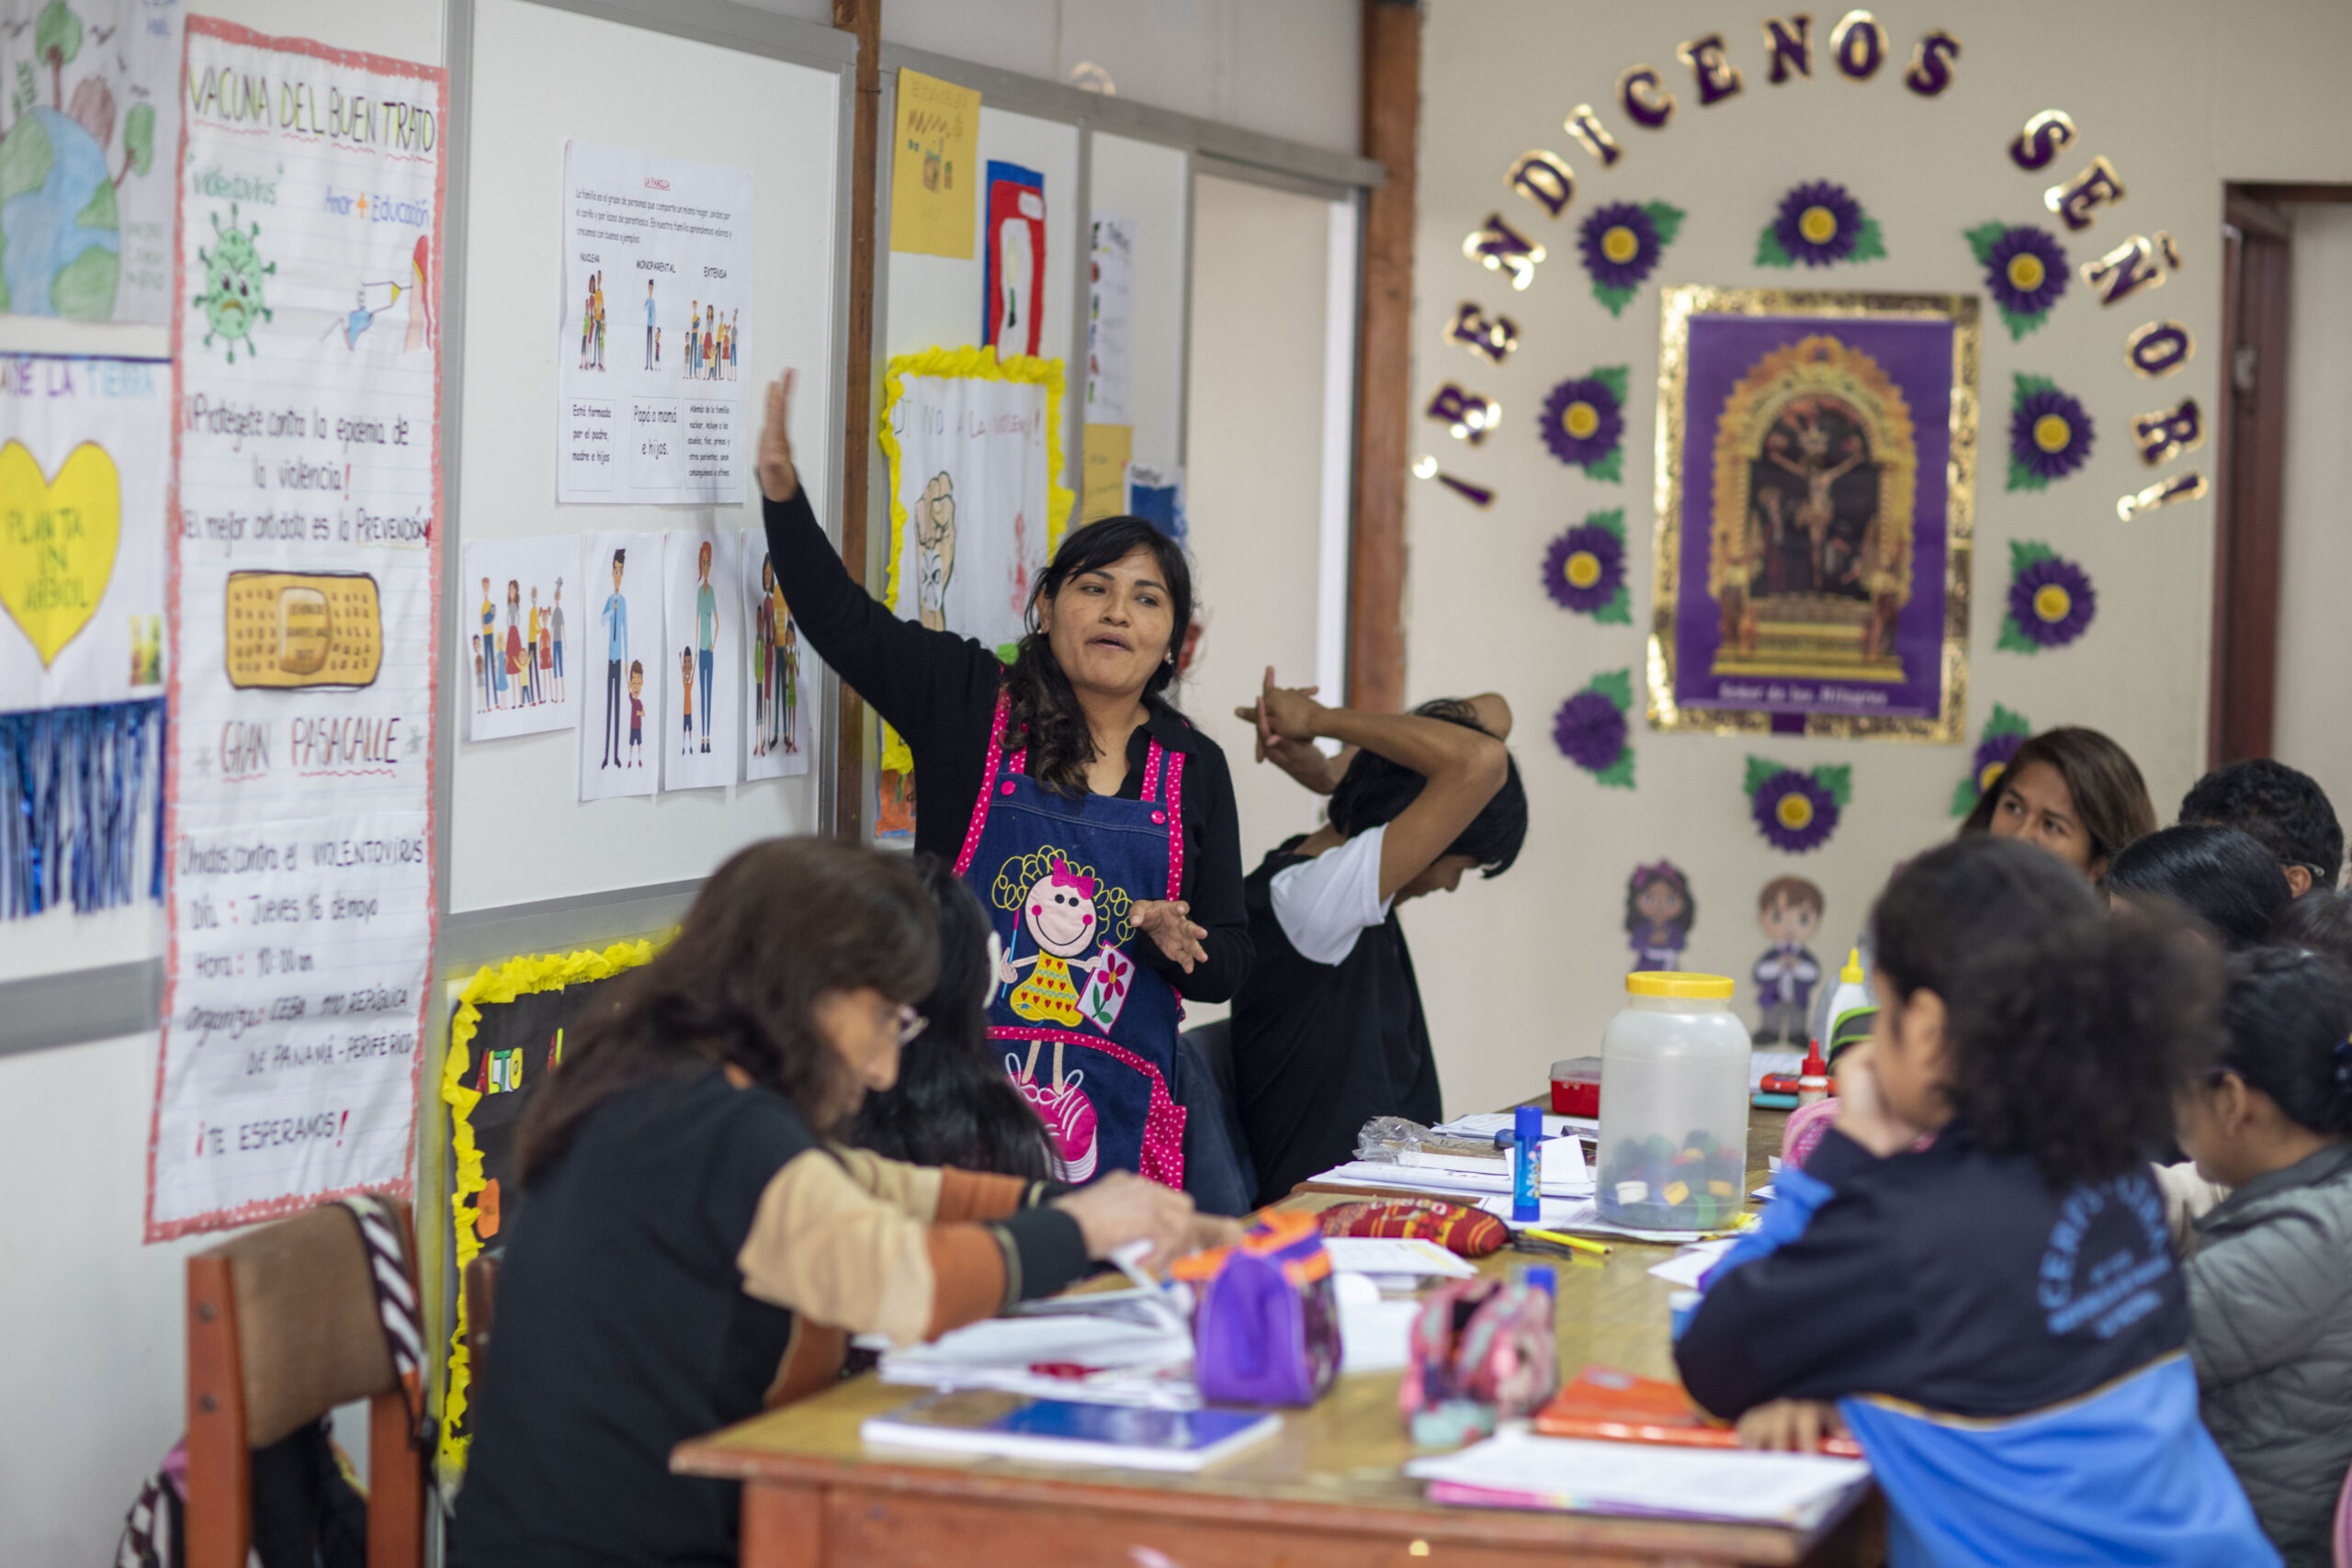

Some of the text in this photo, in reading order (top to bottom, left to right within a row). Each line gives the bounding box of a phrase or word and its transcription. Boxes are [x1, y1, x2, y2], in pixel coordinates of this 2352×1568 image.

[188, 64, 435, 152] VACUNA DEL BUEN TRATO
[289, 716, 401, 766] PASACALLE
[476, 1046, 524, 1095] ALTO
